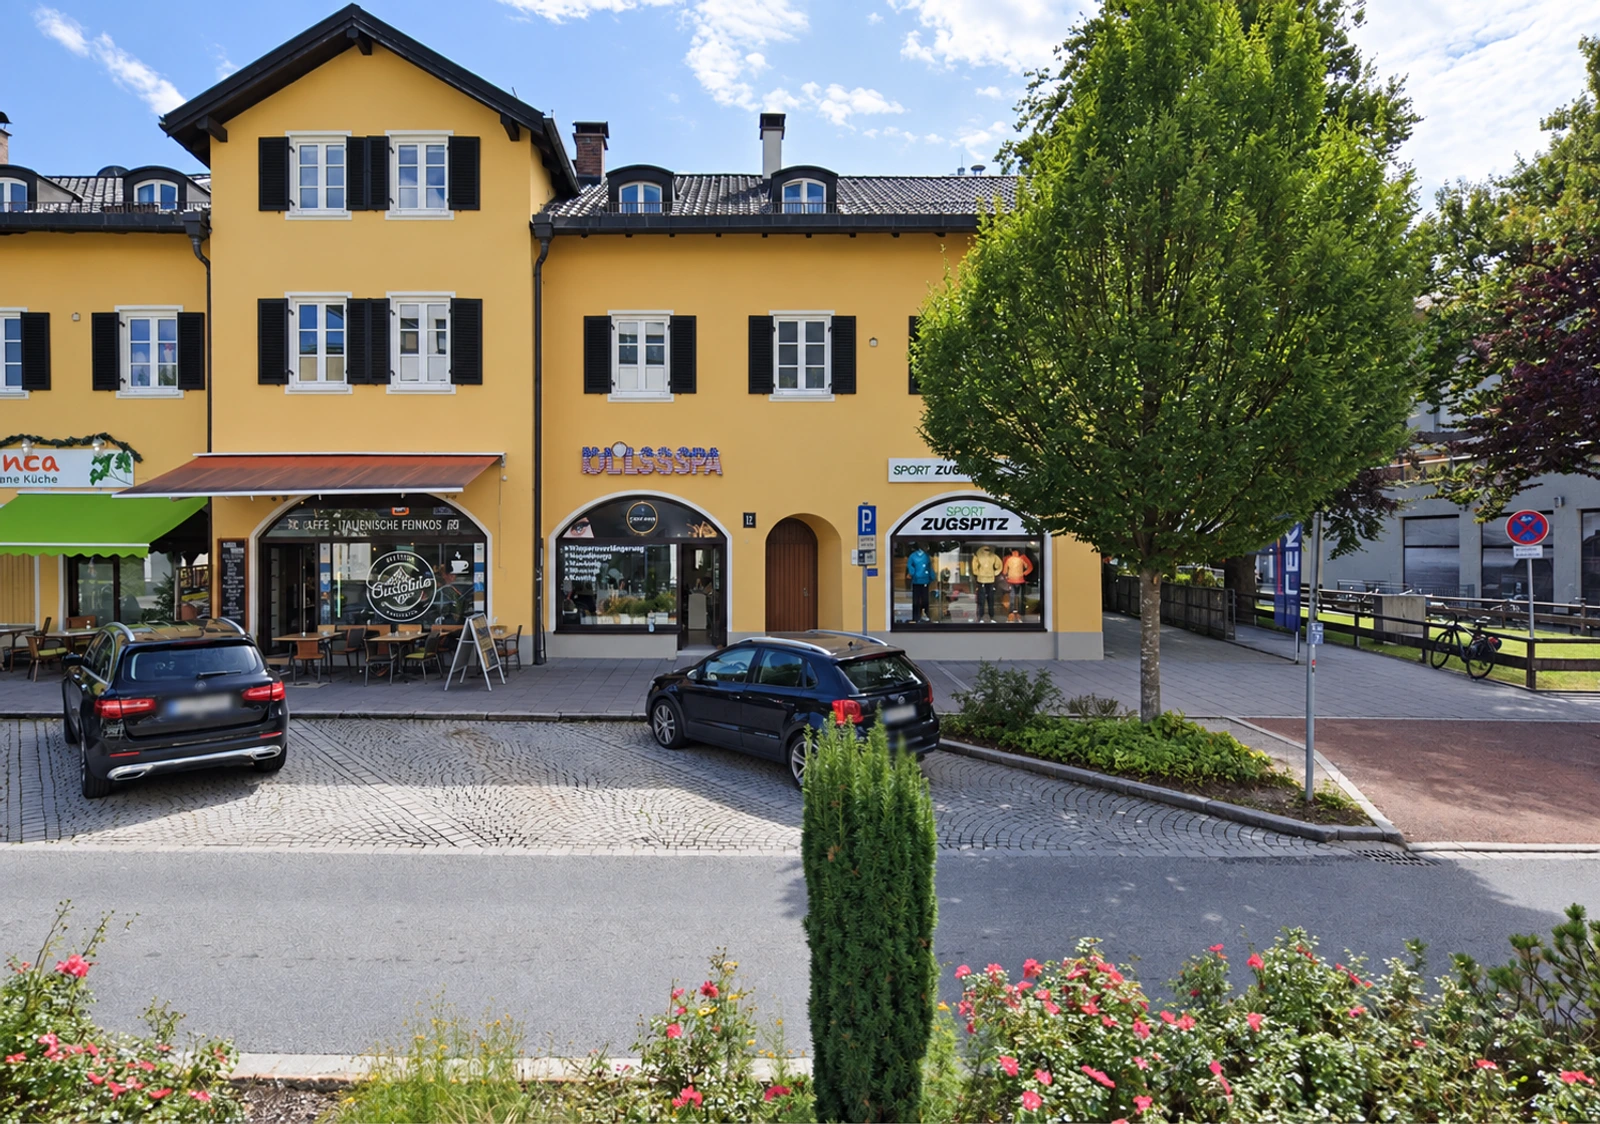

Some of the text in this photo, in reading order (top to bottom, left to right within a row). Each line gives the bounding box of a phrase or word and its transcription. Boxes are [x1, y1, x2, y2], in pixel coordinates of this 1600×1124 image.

[893, 465, 962, 475] SPORT ZUG
[23, 474, 58, 484] Küche
[946, 506, 985, 517] SPORT
[862, 509, 872, 532] P
[921, 518, 1009, 531] ZUGSPITZ
